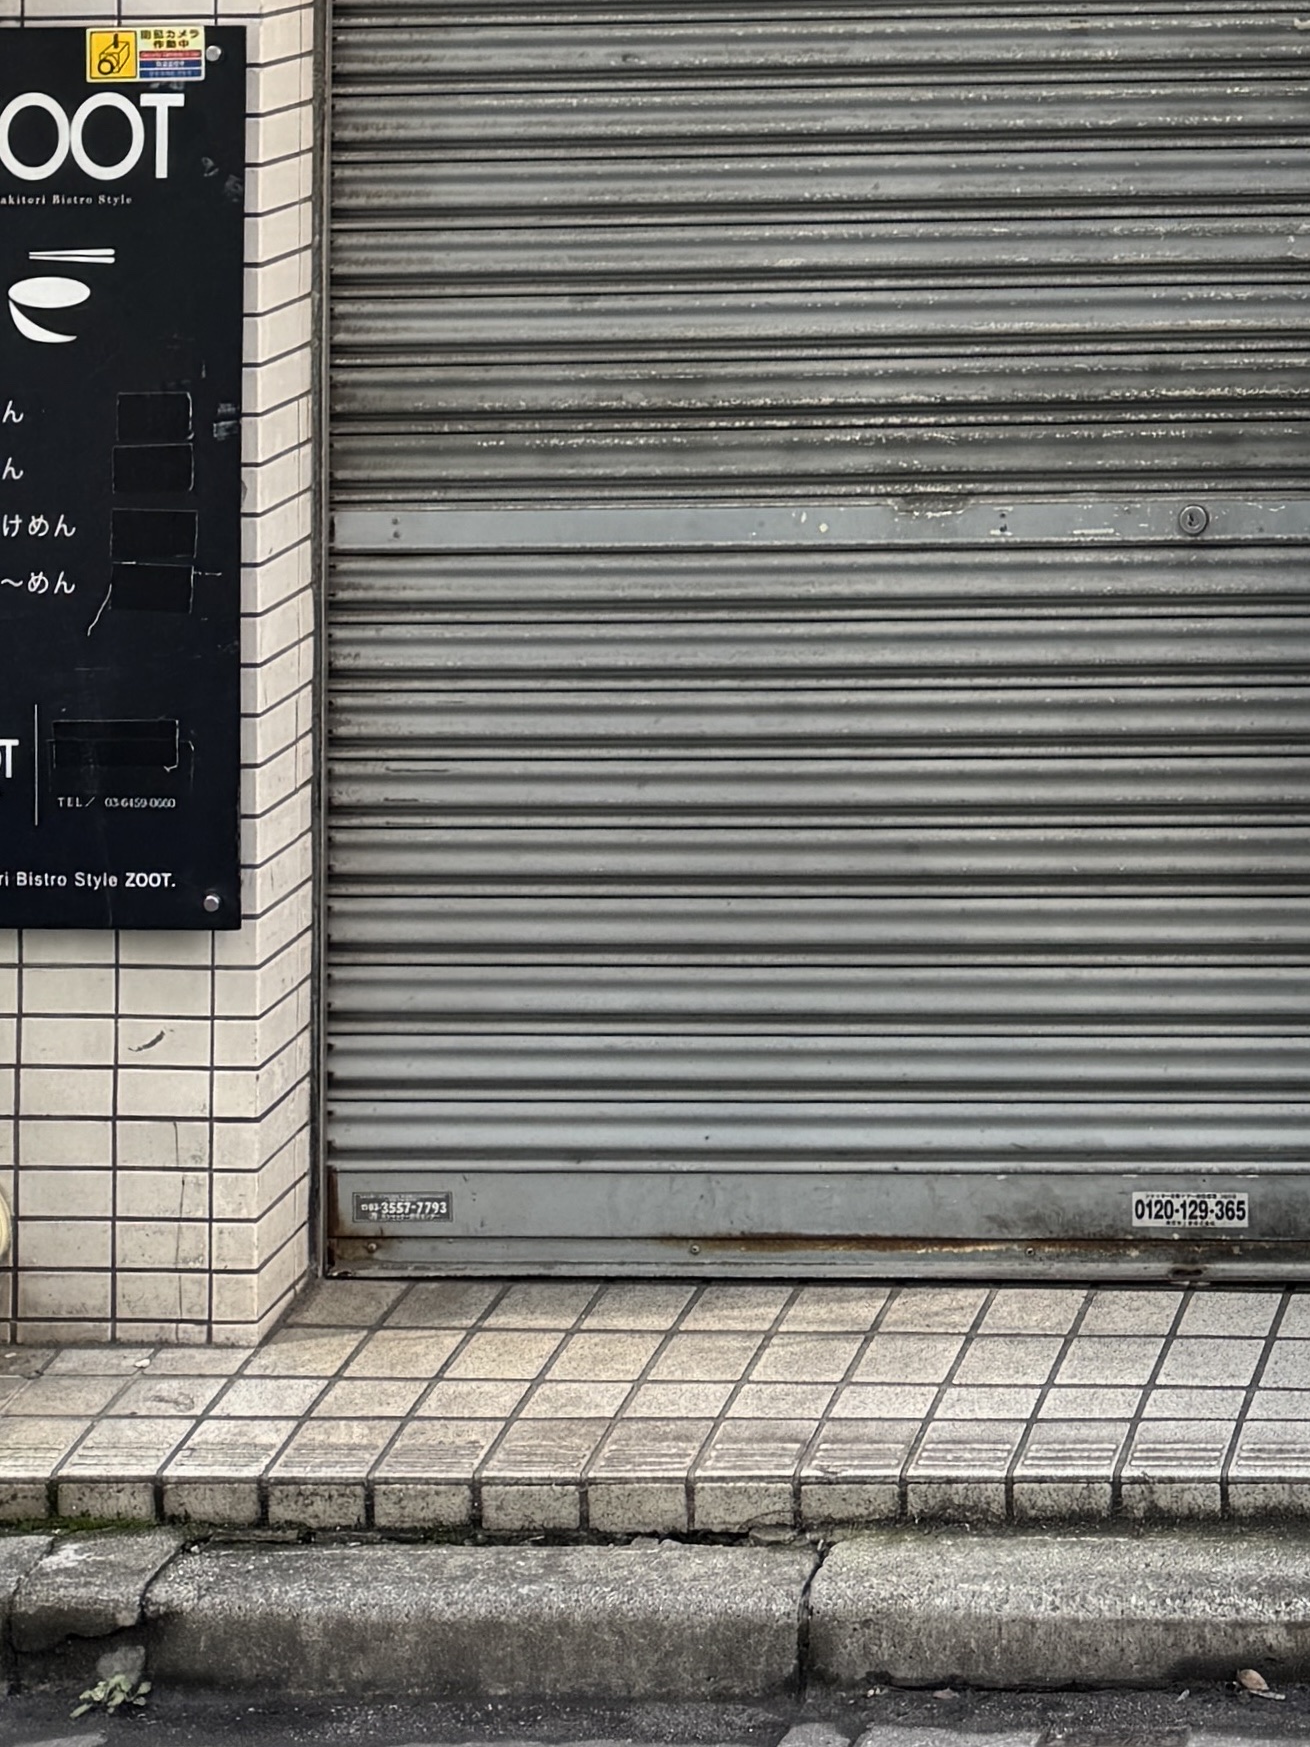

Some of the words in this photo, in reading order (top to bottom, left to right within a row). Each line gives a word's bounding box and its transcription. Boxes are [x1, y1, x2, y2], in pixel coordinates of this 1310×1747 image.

[0, 92, 185, 181] OOT
[0, 194, 46, 205] akitori
[52, 194, 93, 205] Bistro
[98, 194, 133, 206] Style
[2, 400, 24, 423] ん
[2, 457, 24, 480] ん
[2, 514, 76, 537] けめん
[16, 871, 68, 887] Bistro
[74, 872, 118, 890] Style
[125, 872, 176, 888] ZOOT.
